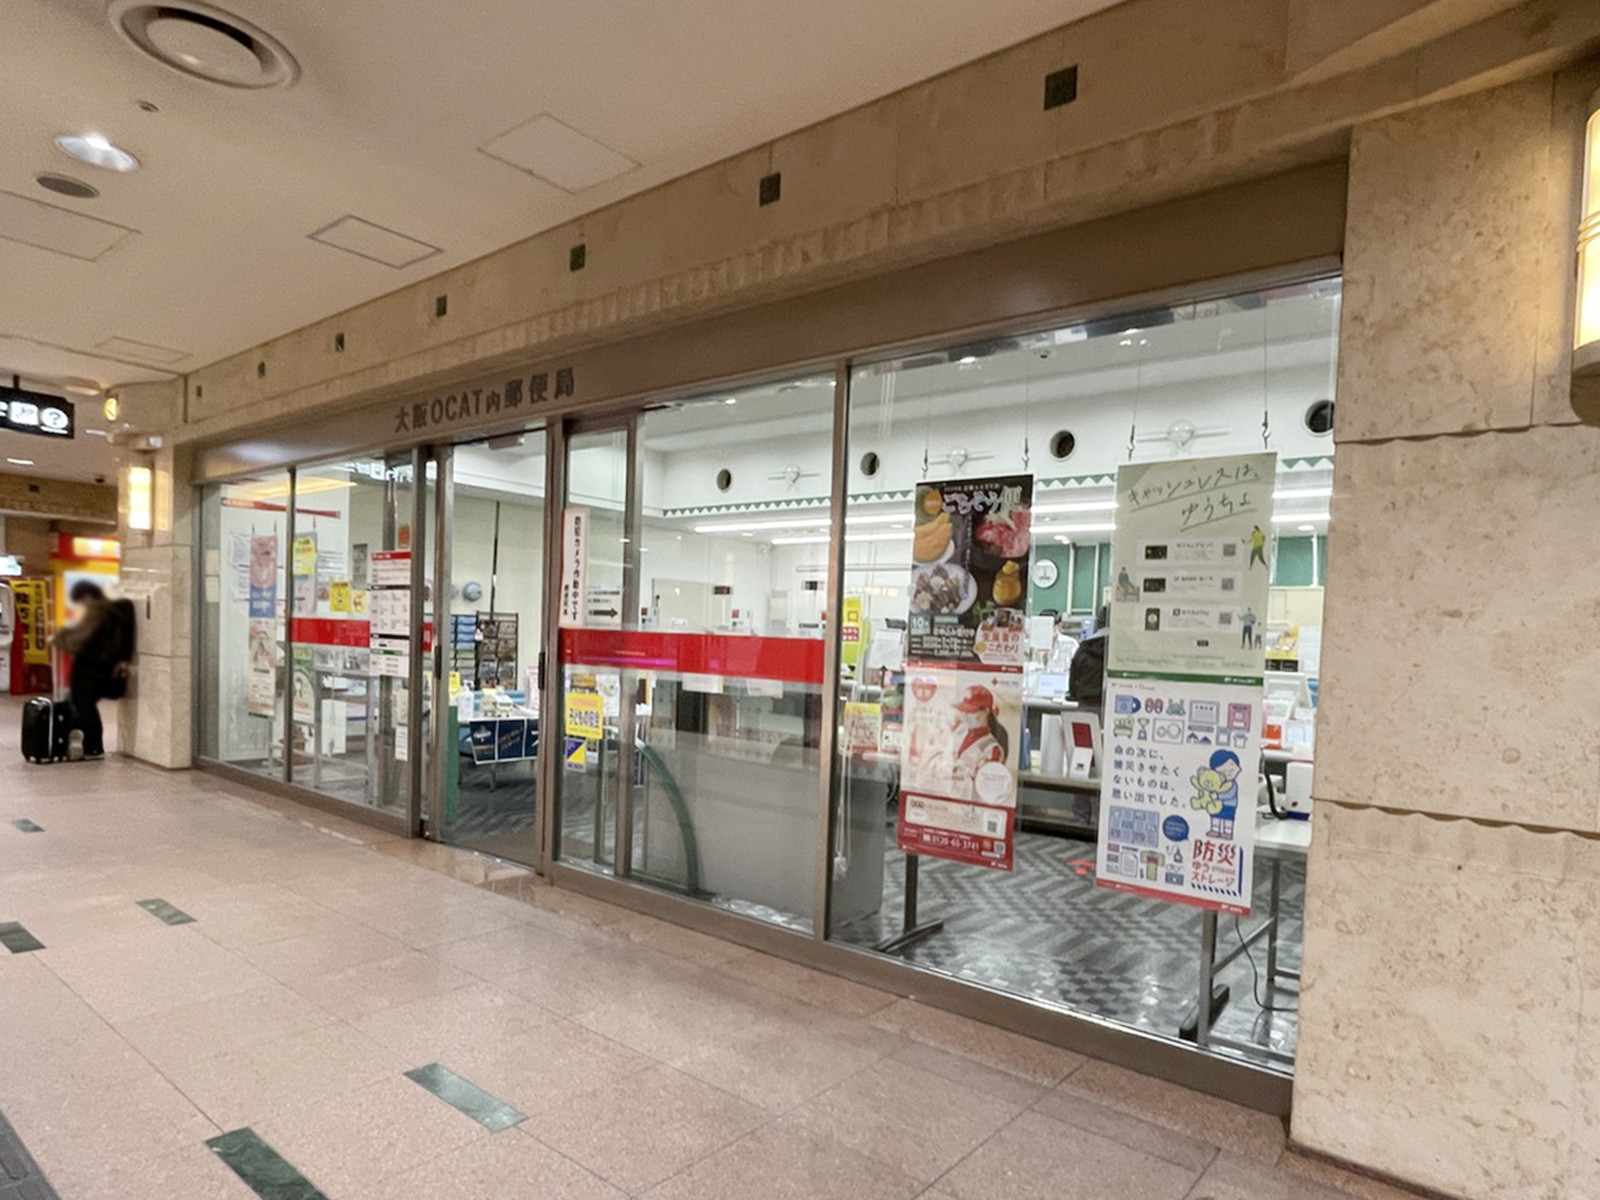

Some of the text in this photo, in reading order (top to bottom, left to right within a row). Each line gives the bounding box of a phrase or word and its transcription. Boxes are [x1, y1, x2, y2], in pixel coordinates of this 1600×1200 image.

[394, 367, 574, 433] 大阪OCAT内郵便局
[1128, 464, 1258, 505] キャッシュレスは、
[1181, 493, 1251, 525] ゆうちょ
[1114, 745, 1163, 760] 命の次に、
[1114, 760, 1180, 777] 被災させたく
[1113, 774, 1174, 791] ないものは、
[1112, 788, 1186, 808] 思い出でした。
[1193, 839, 1236, 866] 防災
[1192, 861, 1210, 872] ゆう
[1192, 872, 1235, 887] ストレージ
